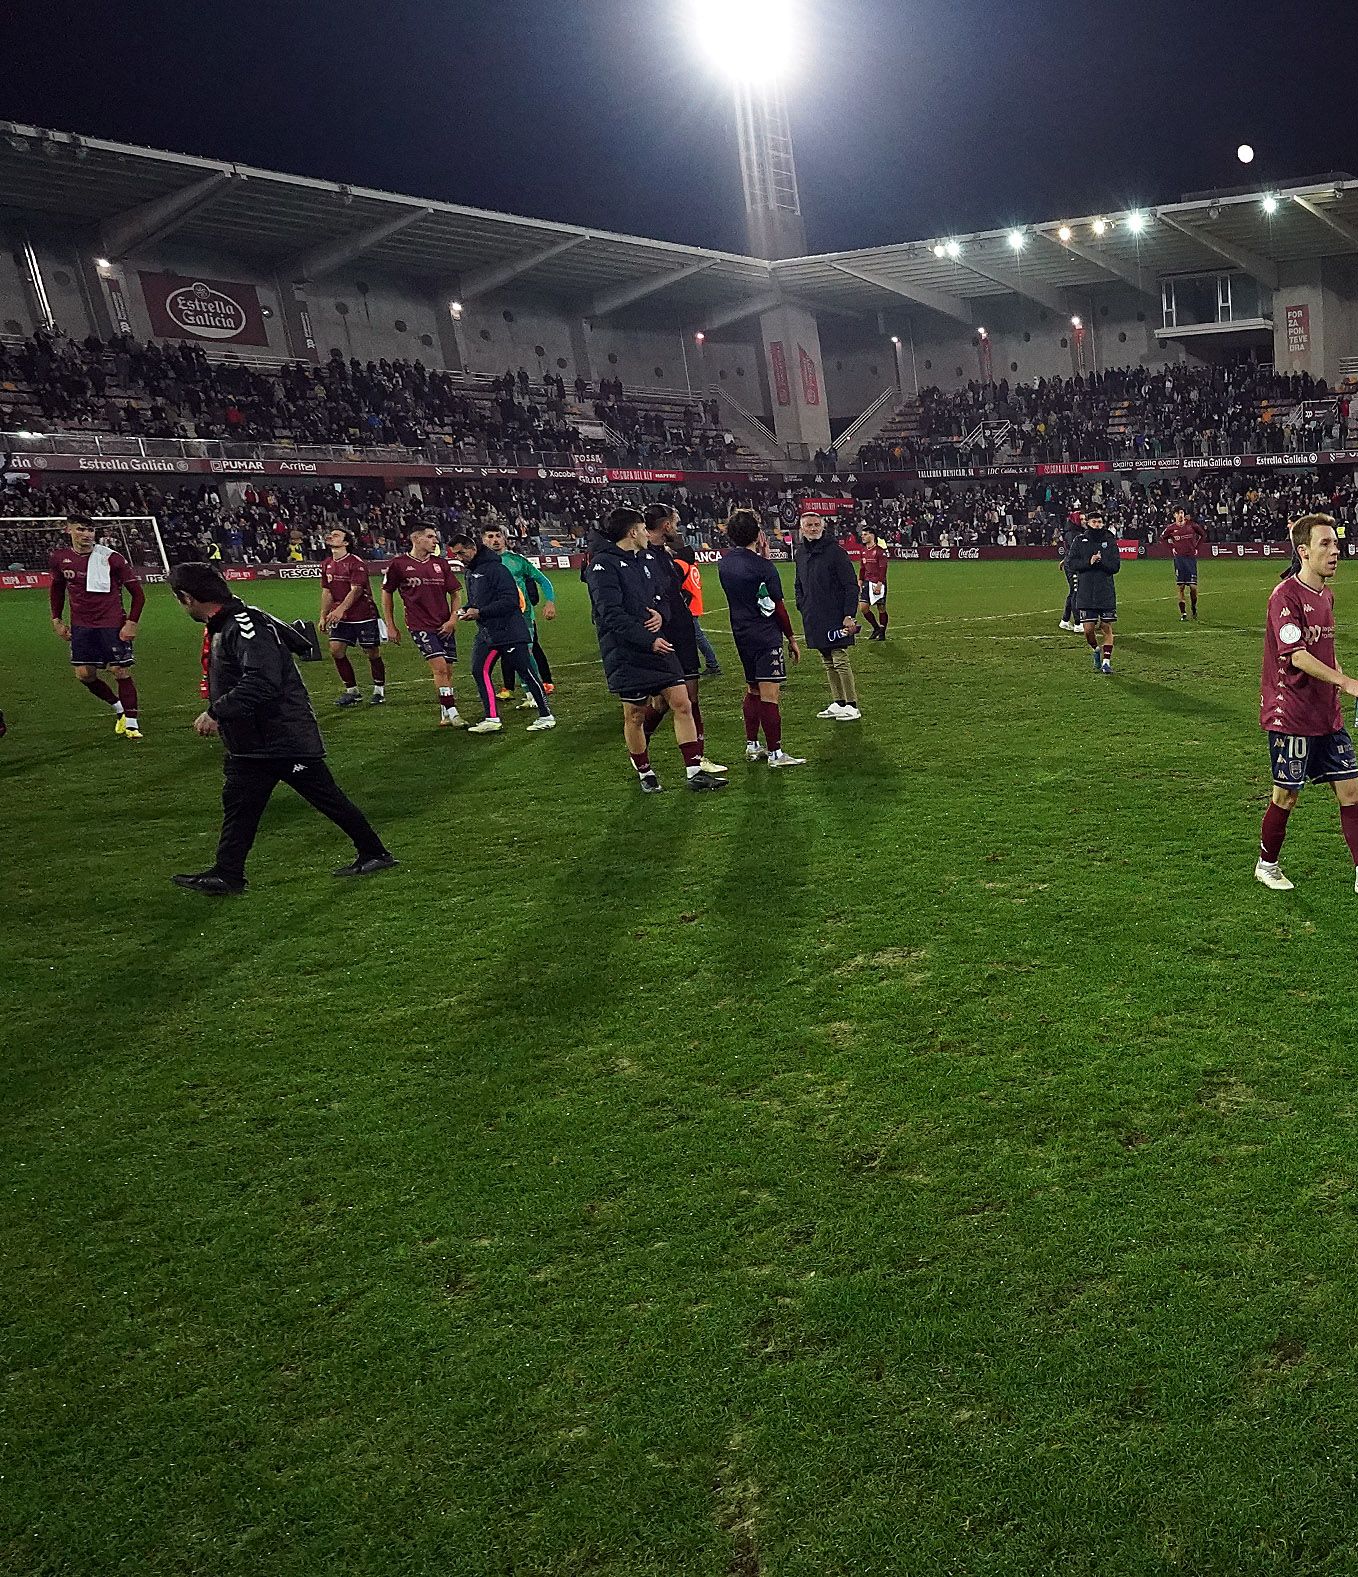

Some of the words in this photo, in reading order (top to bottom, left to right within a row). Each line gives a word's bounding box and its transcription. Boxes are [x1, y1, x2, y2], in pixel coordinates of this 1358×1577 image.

[177, 296, 235, 315] Estrella
[182, 310, 235, 328] Galicia
[79, 458, 128, 470] Estrella
[130, 461, 175, 471] Galicia
[222, 460, 265, 470] PUMAR
[1183, 459, 1208, 468] Estrella
[1209, 458, 1232, 467] Galicia
[1256, 456, 1281, 464] Estrella
[1282, 454, 1307, 464] Galicia
[419, 631, 428, 643] 2
[1287, 736, 1307, 758] 10
